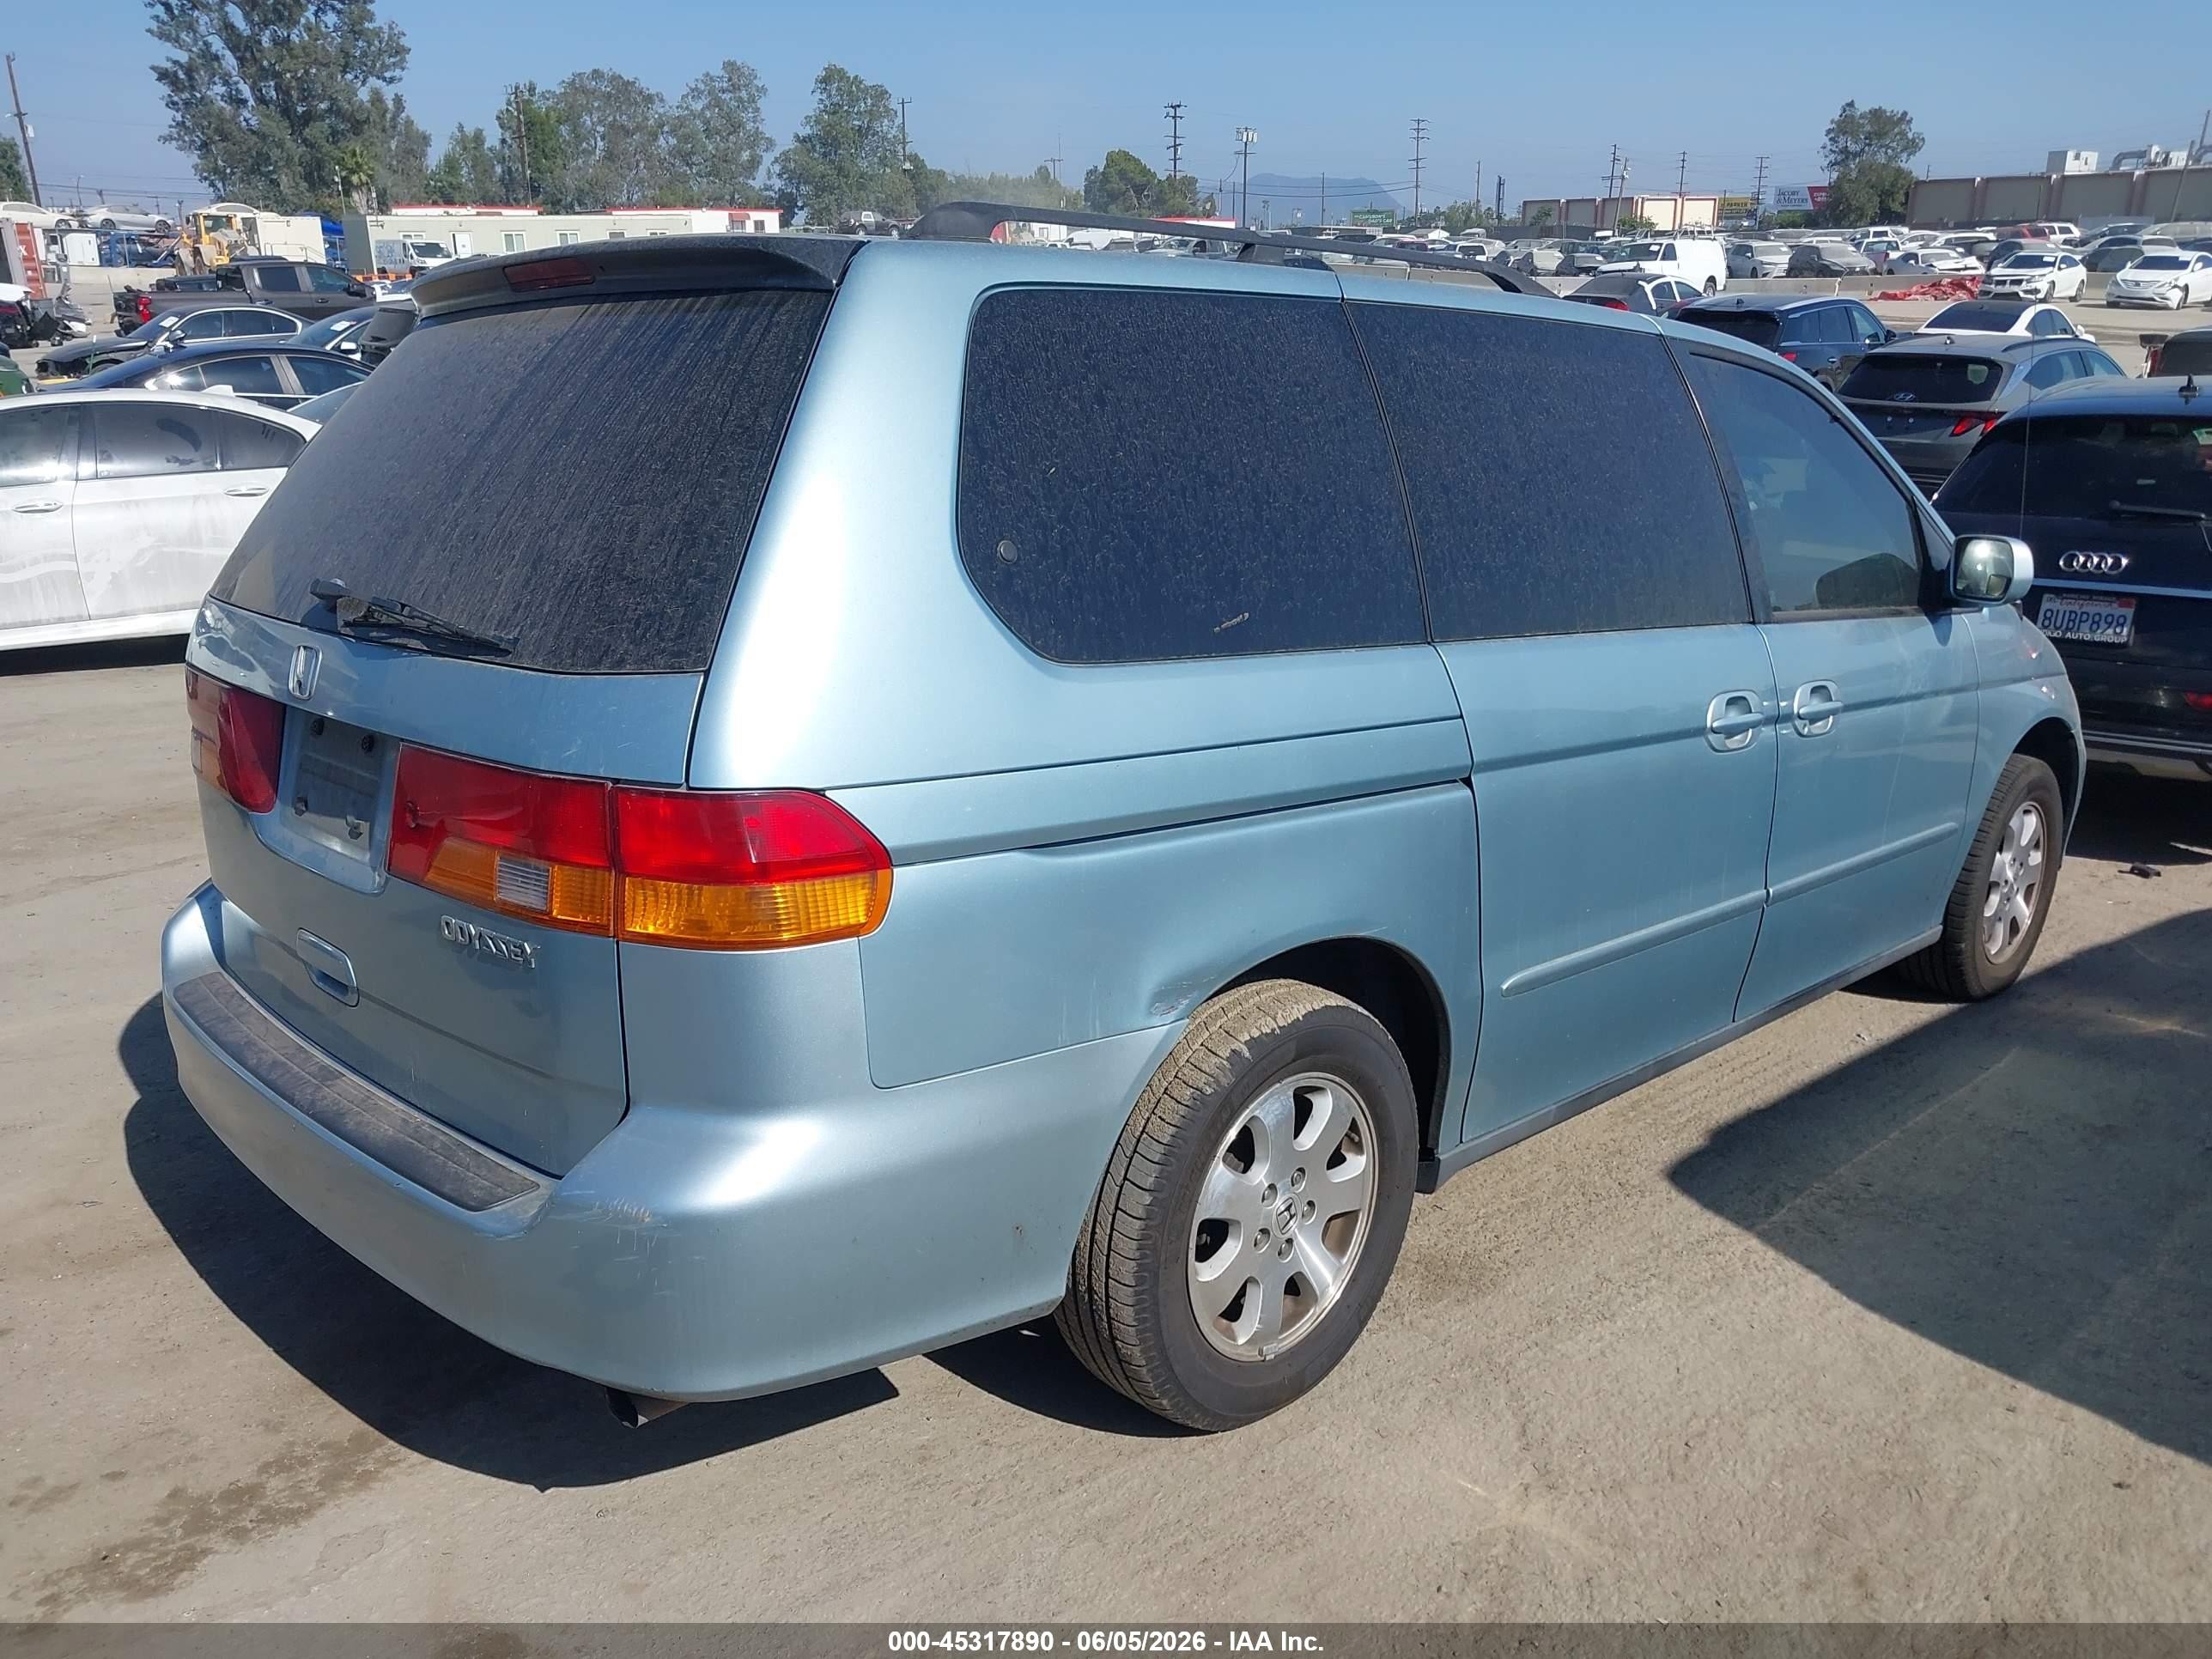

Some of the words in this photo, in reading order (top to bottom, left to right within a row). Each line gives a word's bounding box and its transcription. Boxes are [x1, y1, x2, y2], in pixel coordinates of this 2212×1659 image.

[1778, 188, 1800, 197] JACOBY
[2041, 608, 2127, 635] 8UBP898
[2064, 631, 2091, 641] AUTO
[2094, 635, 2128, 644] GROUP
[441, 915, 541, 969] ODYSSEY
